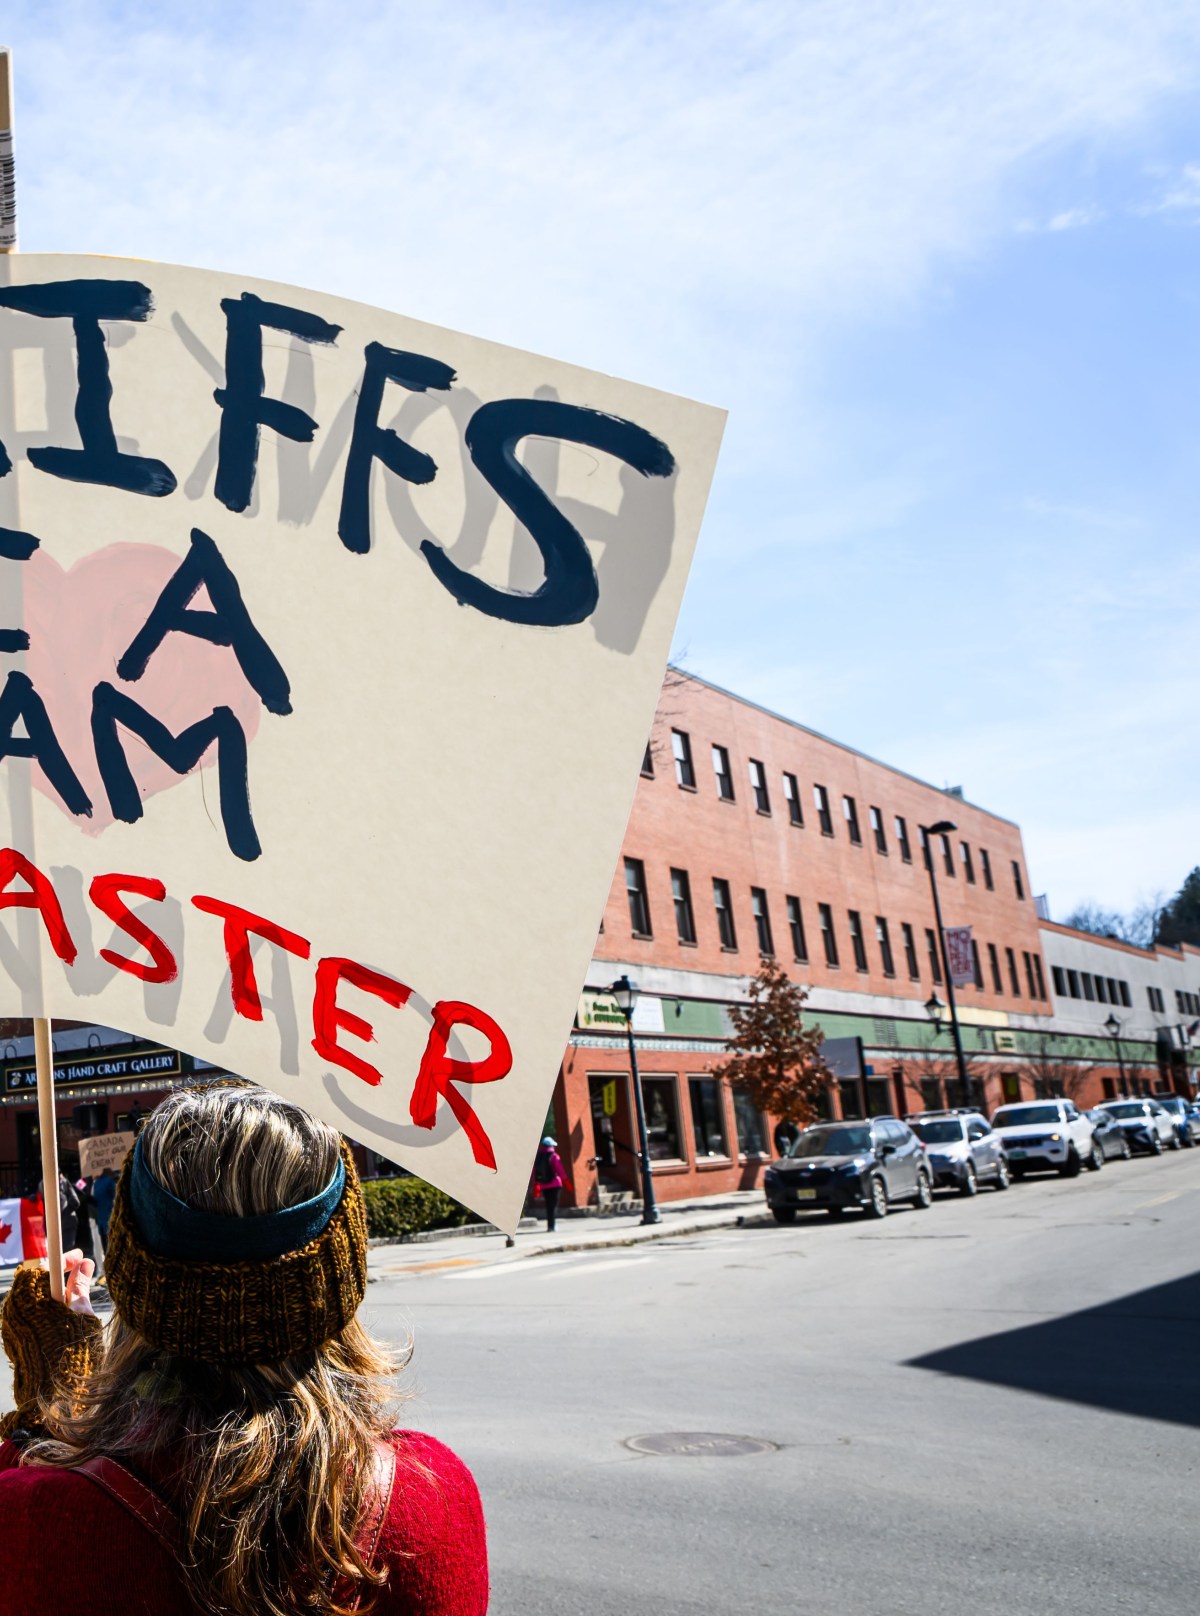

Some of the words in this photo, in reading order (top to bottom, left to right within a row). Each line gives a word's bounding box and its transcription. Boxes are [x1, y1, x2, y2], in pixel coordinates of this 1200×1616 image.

[117, 528, 293, 716] A
[68, 1066, 95, 1080] HAND
[97, 1061, 127, 1075] CRAFT
[131, 1055, 174, 1072] GALLERY
[86, 1136, 124, 1150] CANADA
